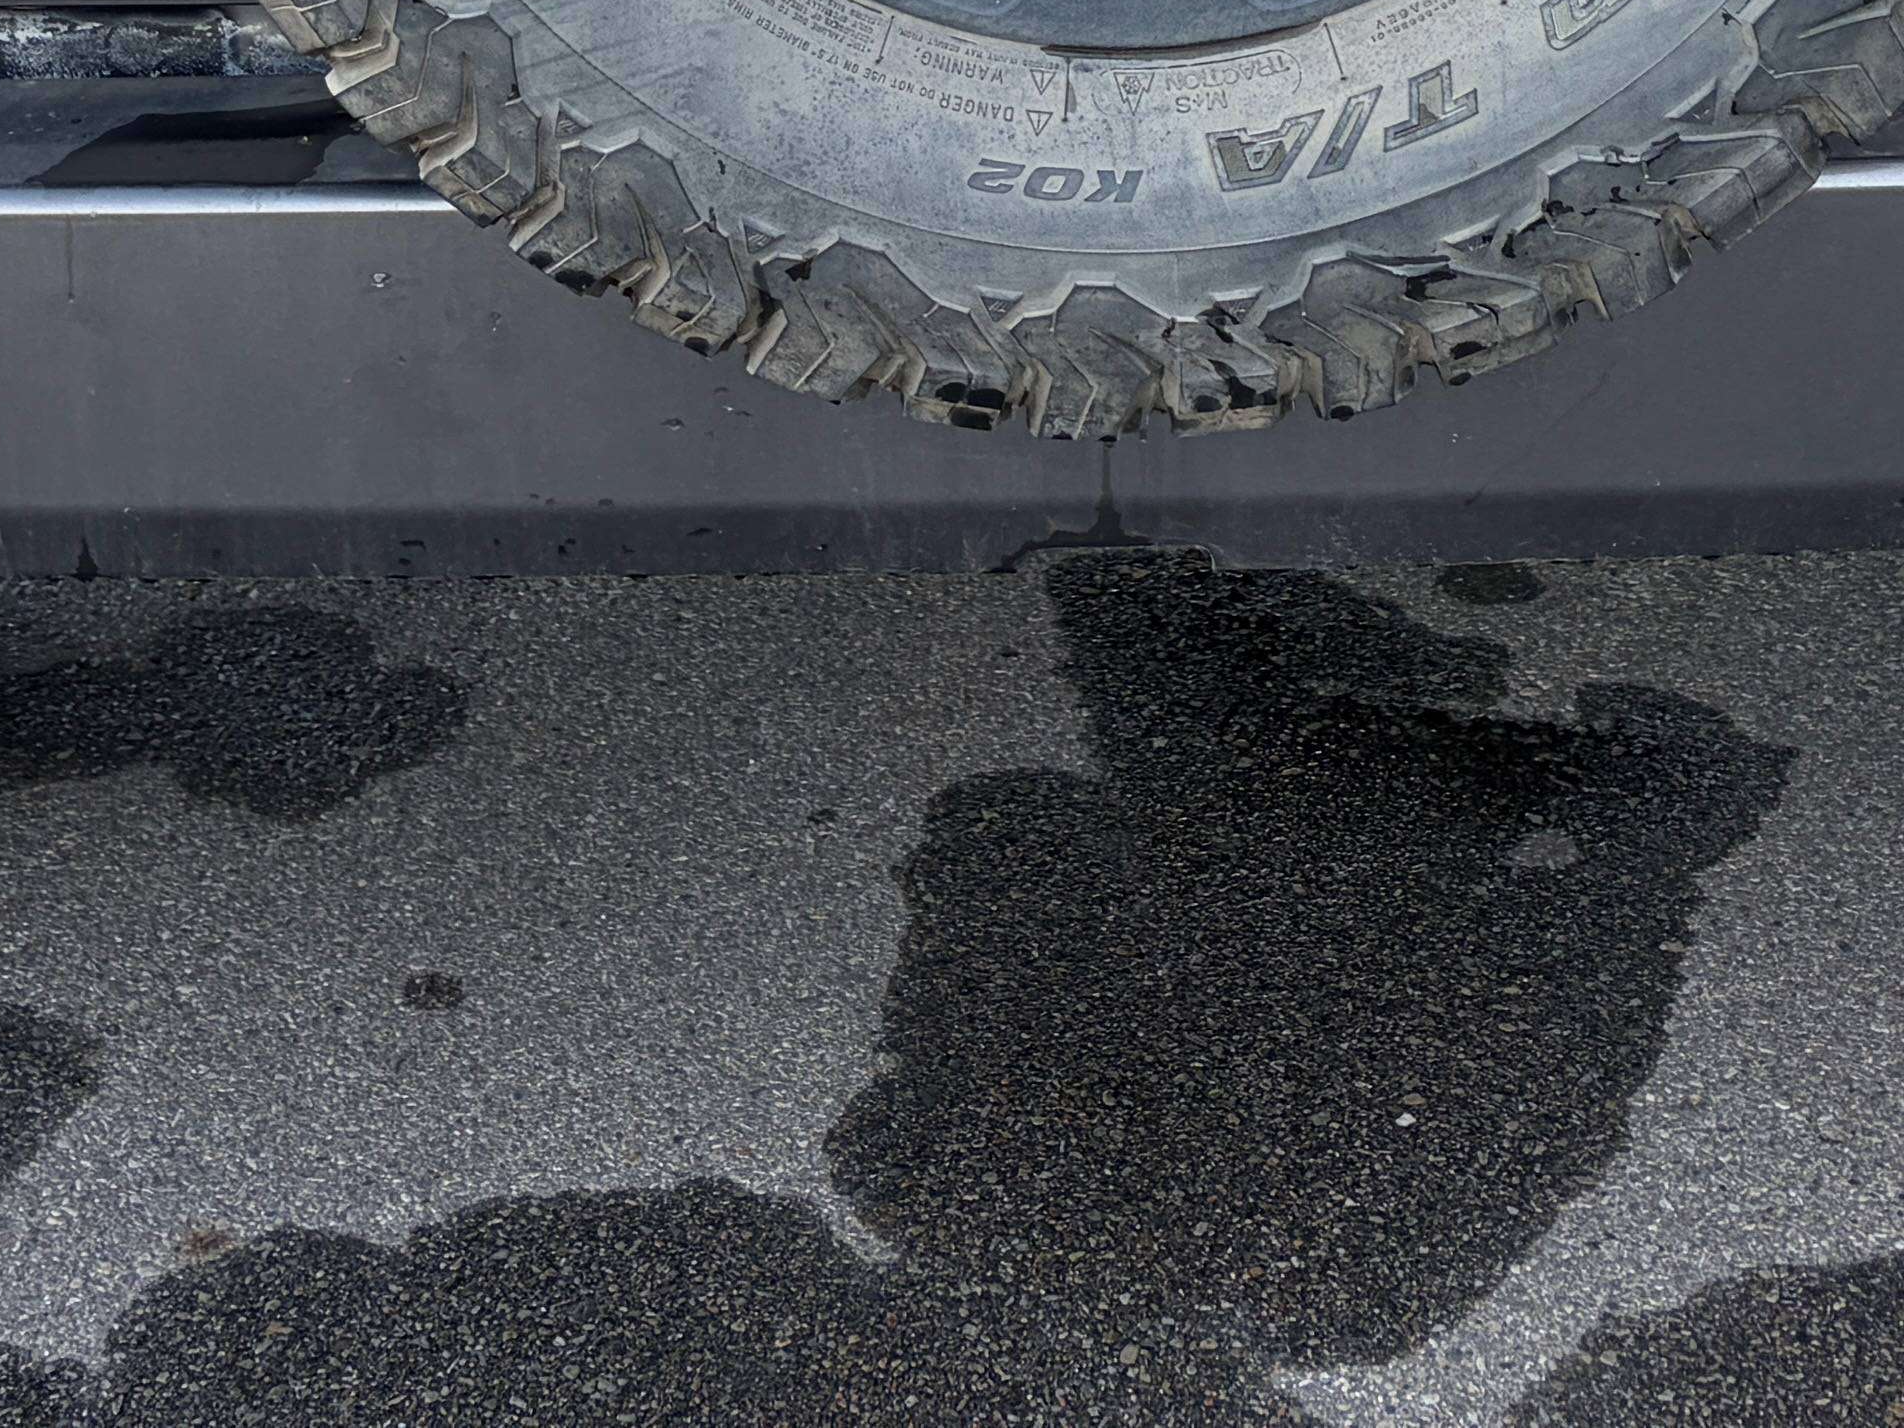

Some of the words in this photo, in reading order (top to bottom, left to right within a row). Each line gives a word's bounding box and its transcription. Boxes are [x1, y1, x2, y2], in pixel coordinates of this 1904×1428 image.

[753, 12, 812, 53] DIAMETER
[860, 65, 888, 86] USE
[888, 75, 916, 96] NOT
[1164, 52, 1292, 92] TRACTION
[917, 84, 937, 101] DO
[936, 89, 1016, 124] DANGER
[1173, 88, 1229, 114] M+S
[1205, 59, 1479, 192] T/A
[966, 157, 1144, 203] KO2
